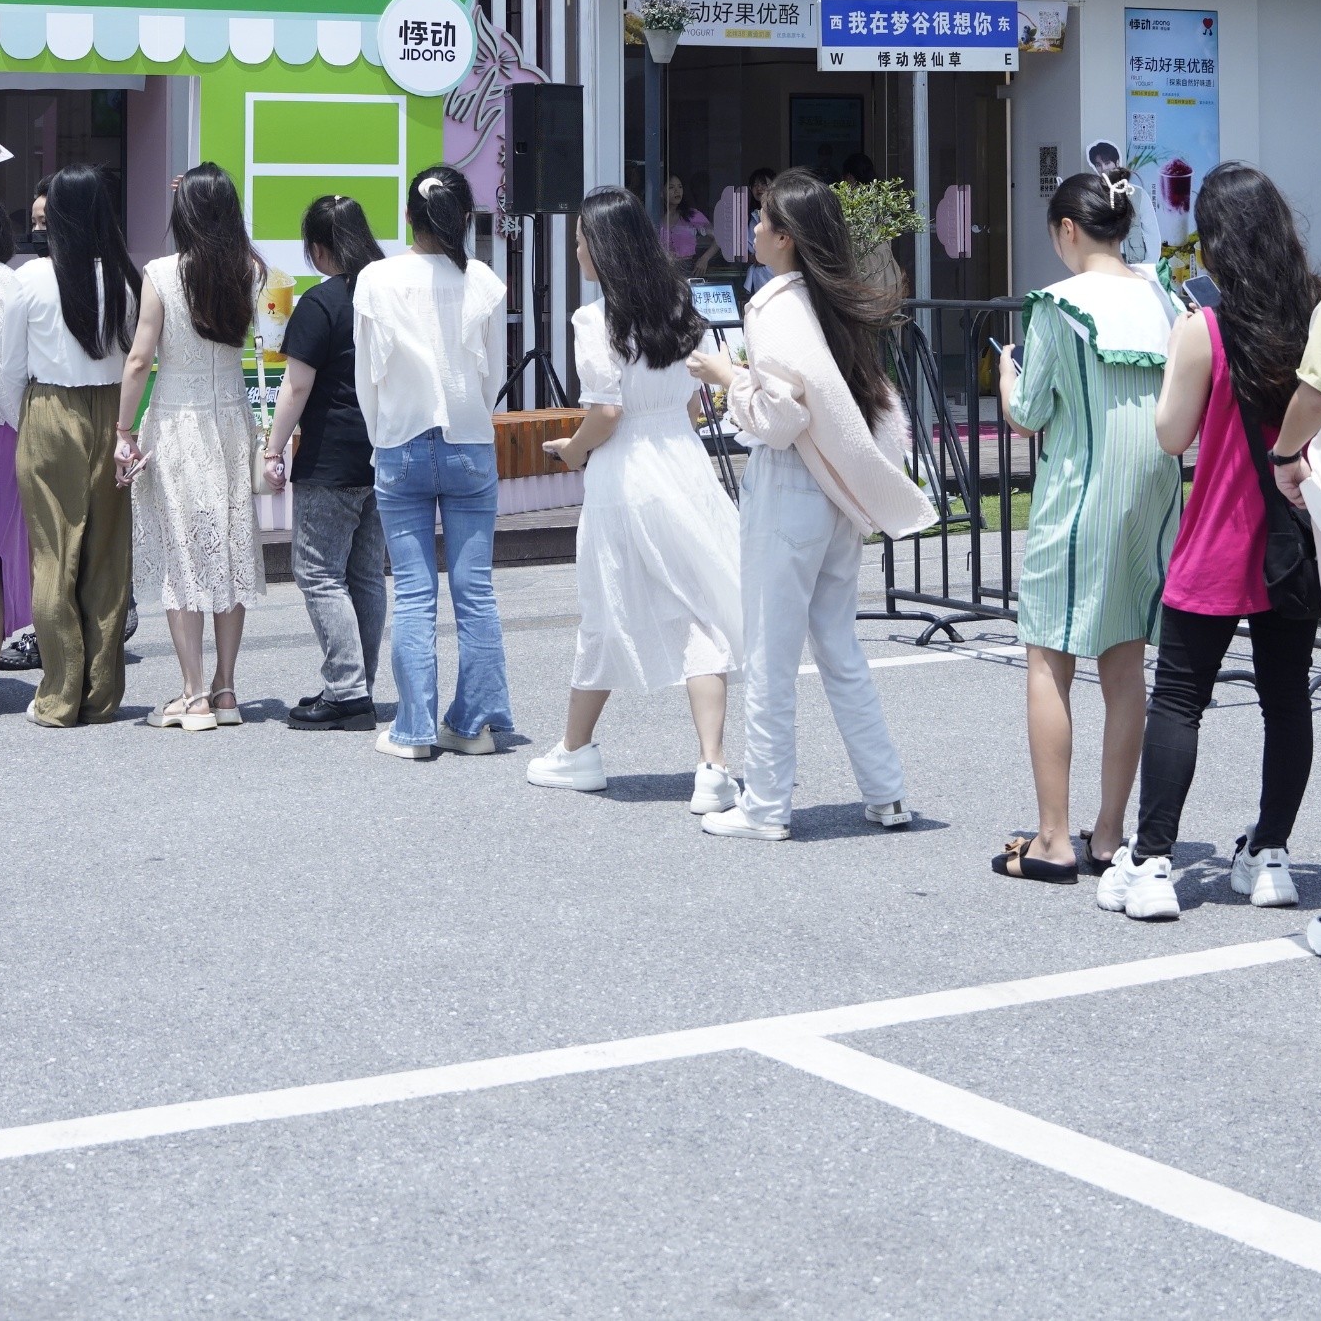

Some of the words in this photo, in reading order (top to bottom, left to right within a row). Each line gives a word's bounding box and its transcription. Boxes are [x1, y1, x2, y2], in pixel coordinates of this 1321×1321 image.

[690, 1, 800, 26] 动好果优酪
[686, 28, 715, 37] YOGURT
[829, 15, 842, 30] 西
[848, 11, 993, 36] 我在梦谷很想你
[998, 16, 1011, 32] 东
[398, 19, 456, 47] 悸动
[830, 52, 843, 65] W
[878, 51, 962, 67] 悸动烧仙草
[1005, 53, 1012, 65] E
[1130, 56, 1215, 74] 悸动好果优酪
[693, 291, 732, 304] 好果优酪
